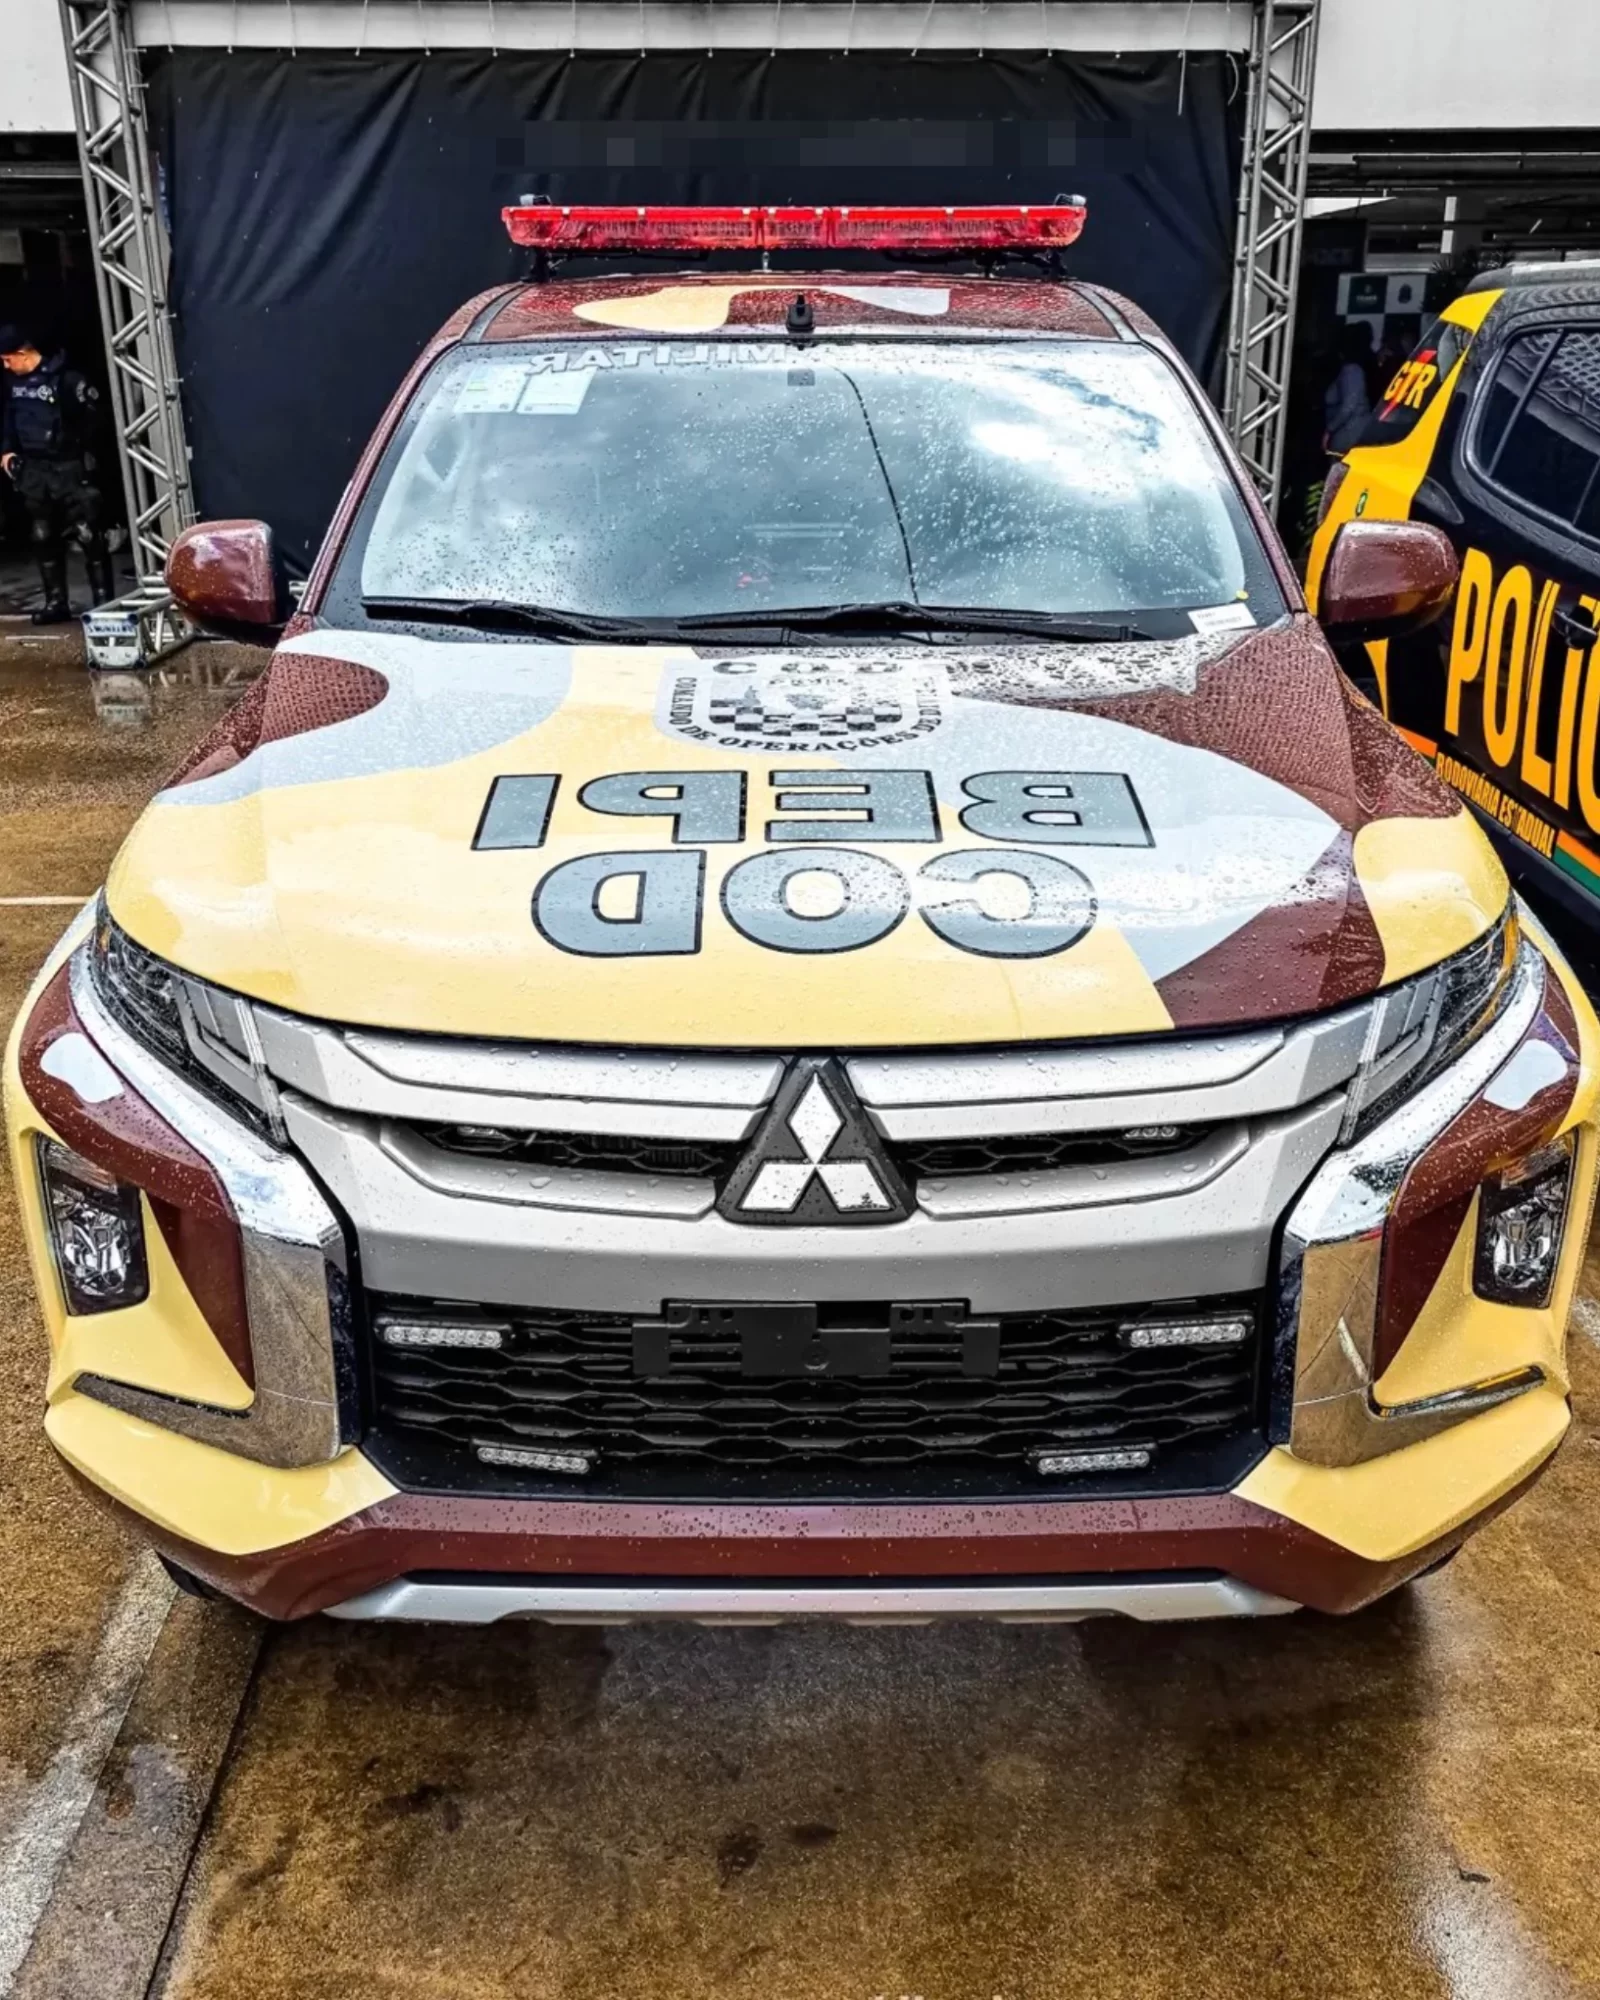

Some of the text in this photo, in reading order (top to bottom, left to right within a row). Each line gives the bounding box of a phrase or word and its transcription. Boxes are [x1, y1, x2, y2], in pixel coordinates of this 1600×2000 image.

[1384, 361, 1438, 408] GTR
[675, 725, 717, 741] DE
[1436, 752, 1501, 818] RODOVIÁRIA
